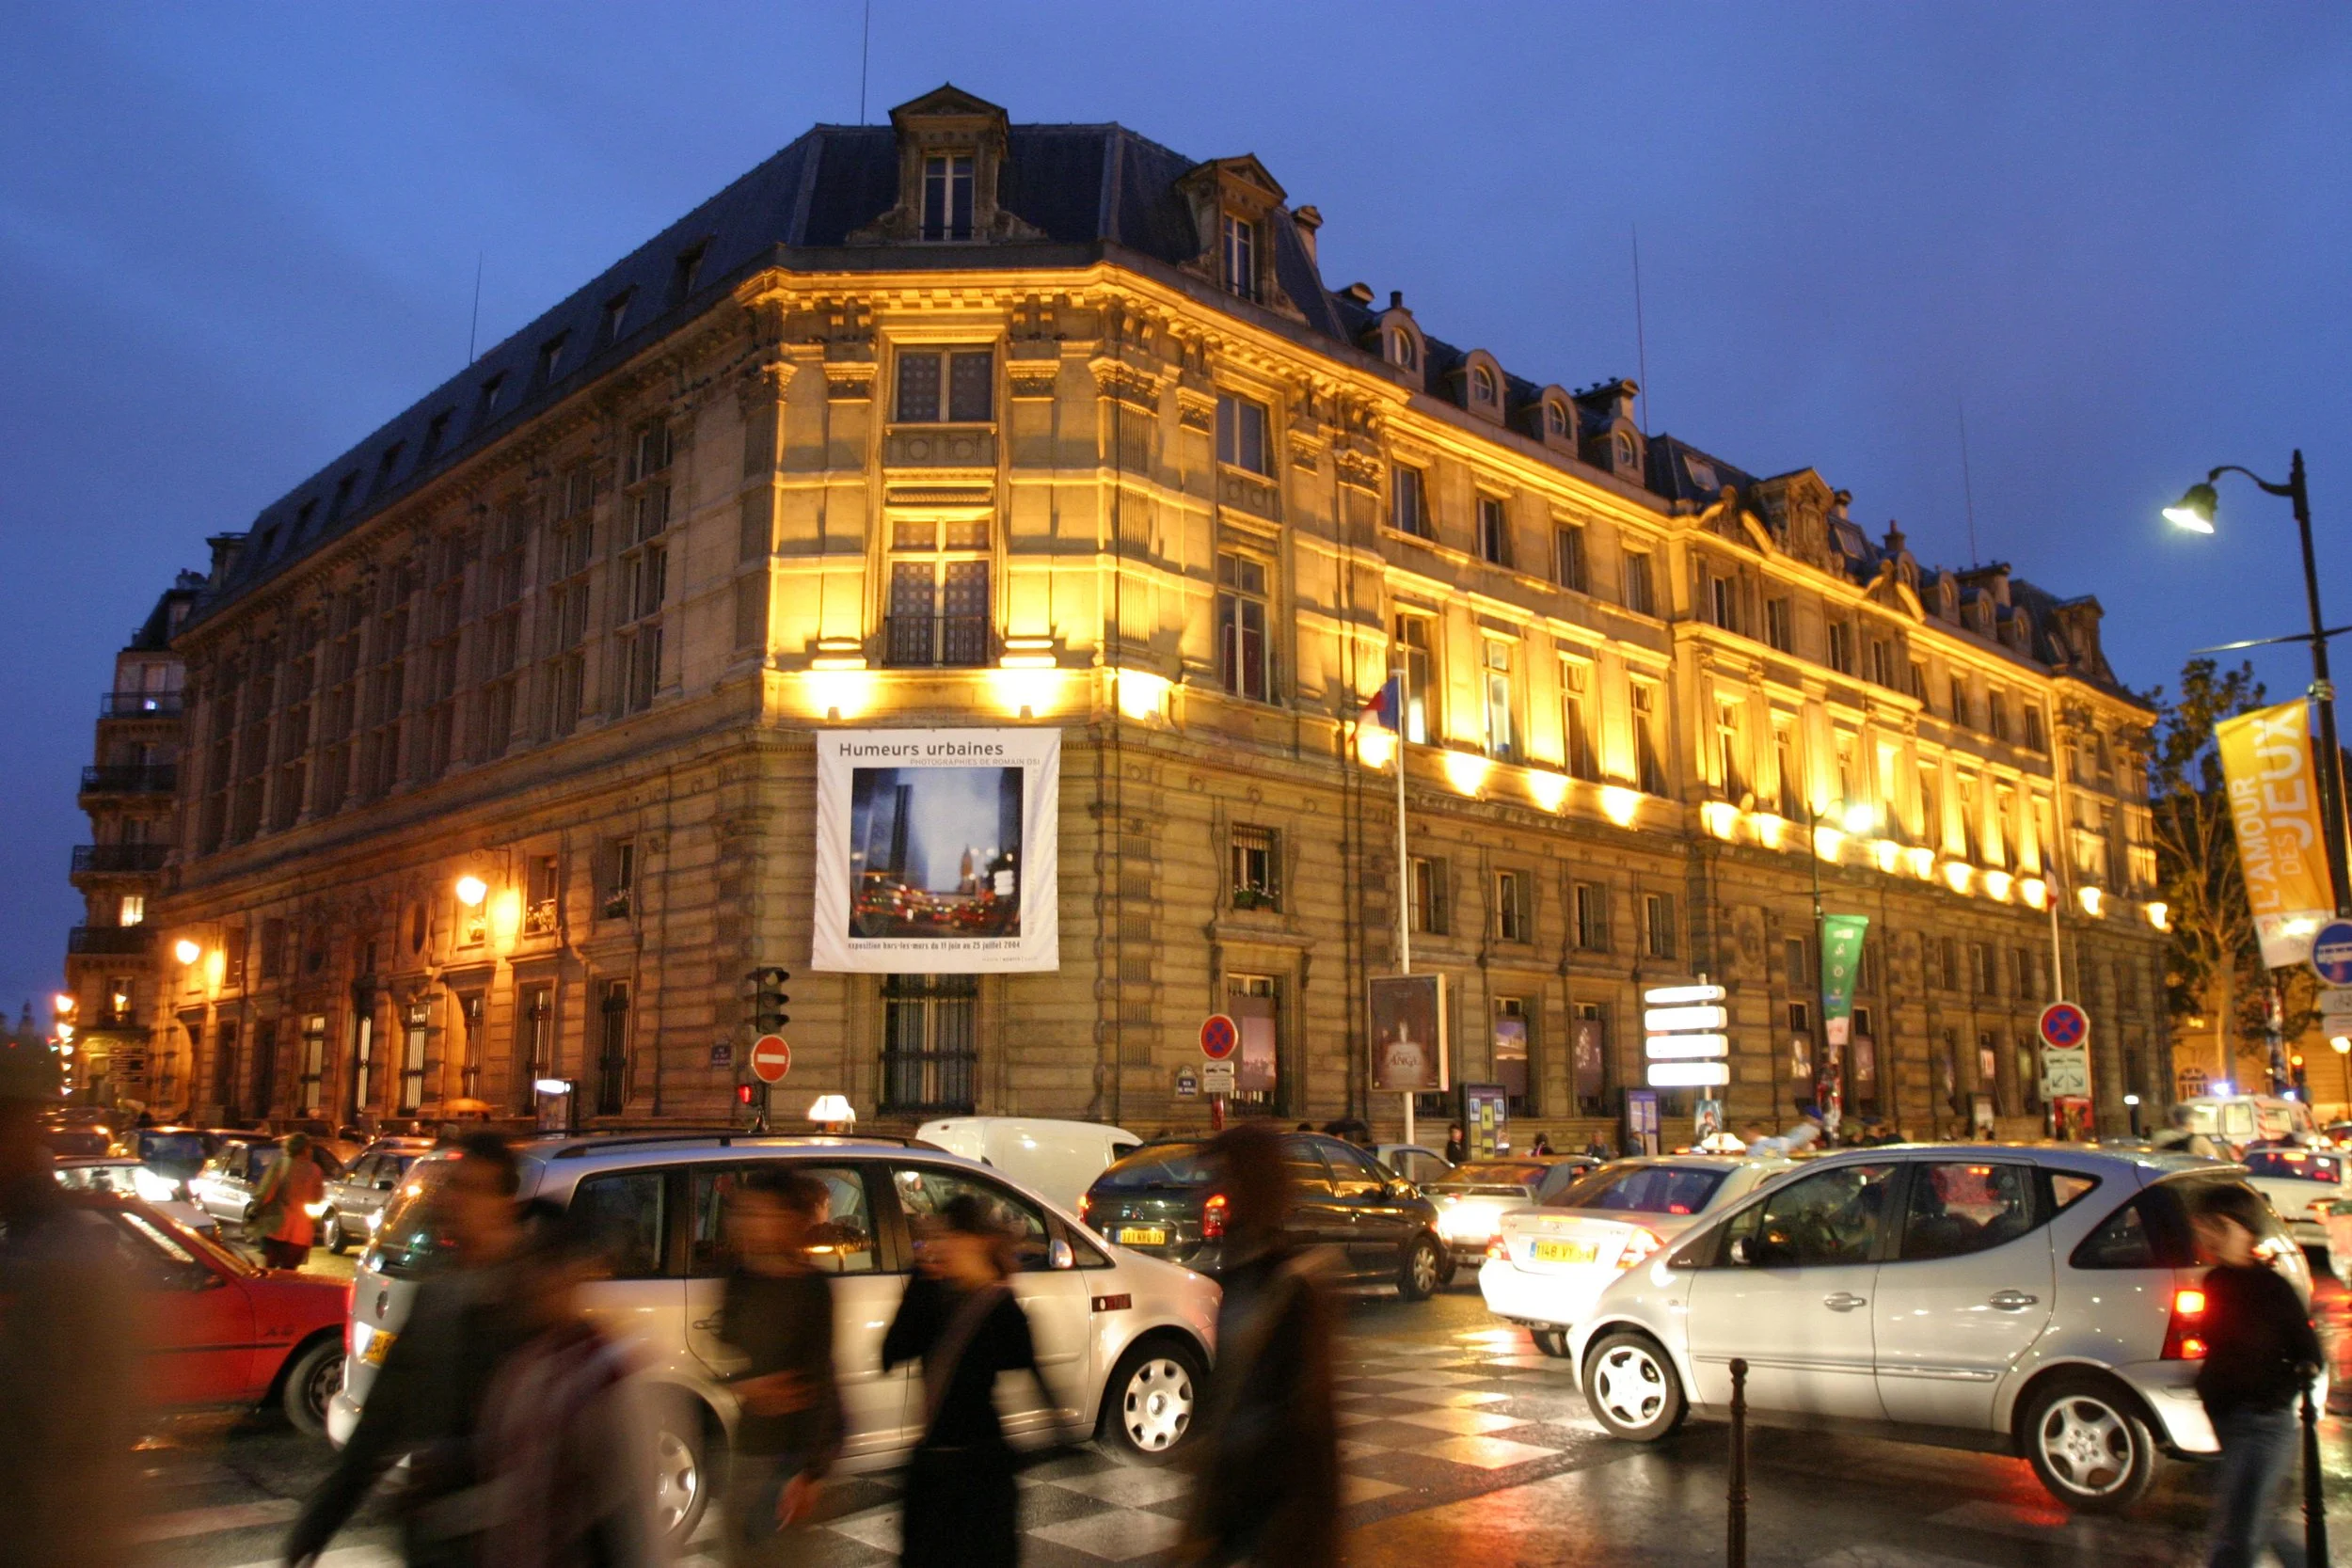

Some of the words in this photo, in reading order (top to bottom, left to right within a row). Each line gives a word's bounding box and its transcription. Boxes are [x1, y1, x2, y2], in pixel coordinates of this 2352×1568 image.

[839, 741, 920, 757] Humeurs
[927, 741, 1004, 756] urbaines
[2251, 706, 2313, 849] JEUX
[2231, 776, 2280, 910] L'AMOUR
[2275, 833, 2303, 876] DES
[848, 942, 882, 950] exposition
[972, 941, 981, 949] 25
[1003, 941, 1021, 949] 2004
